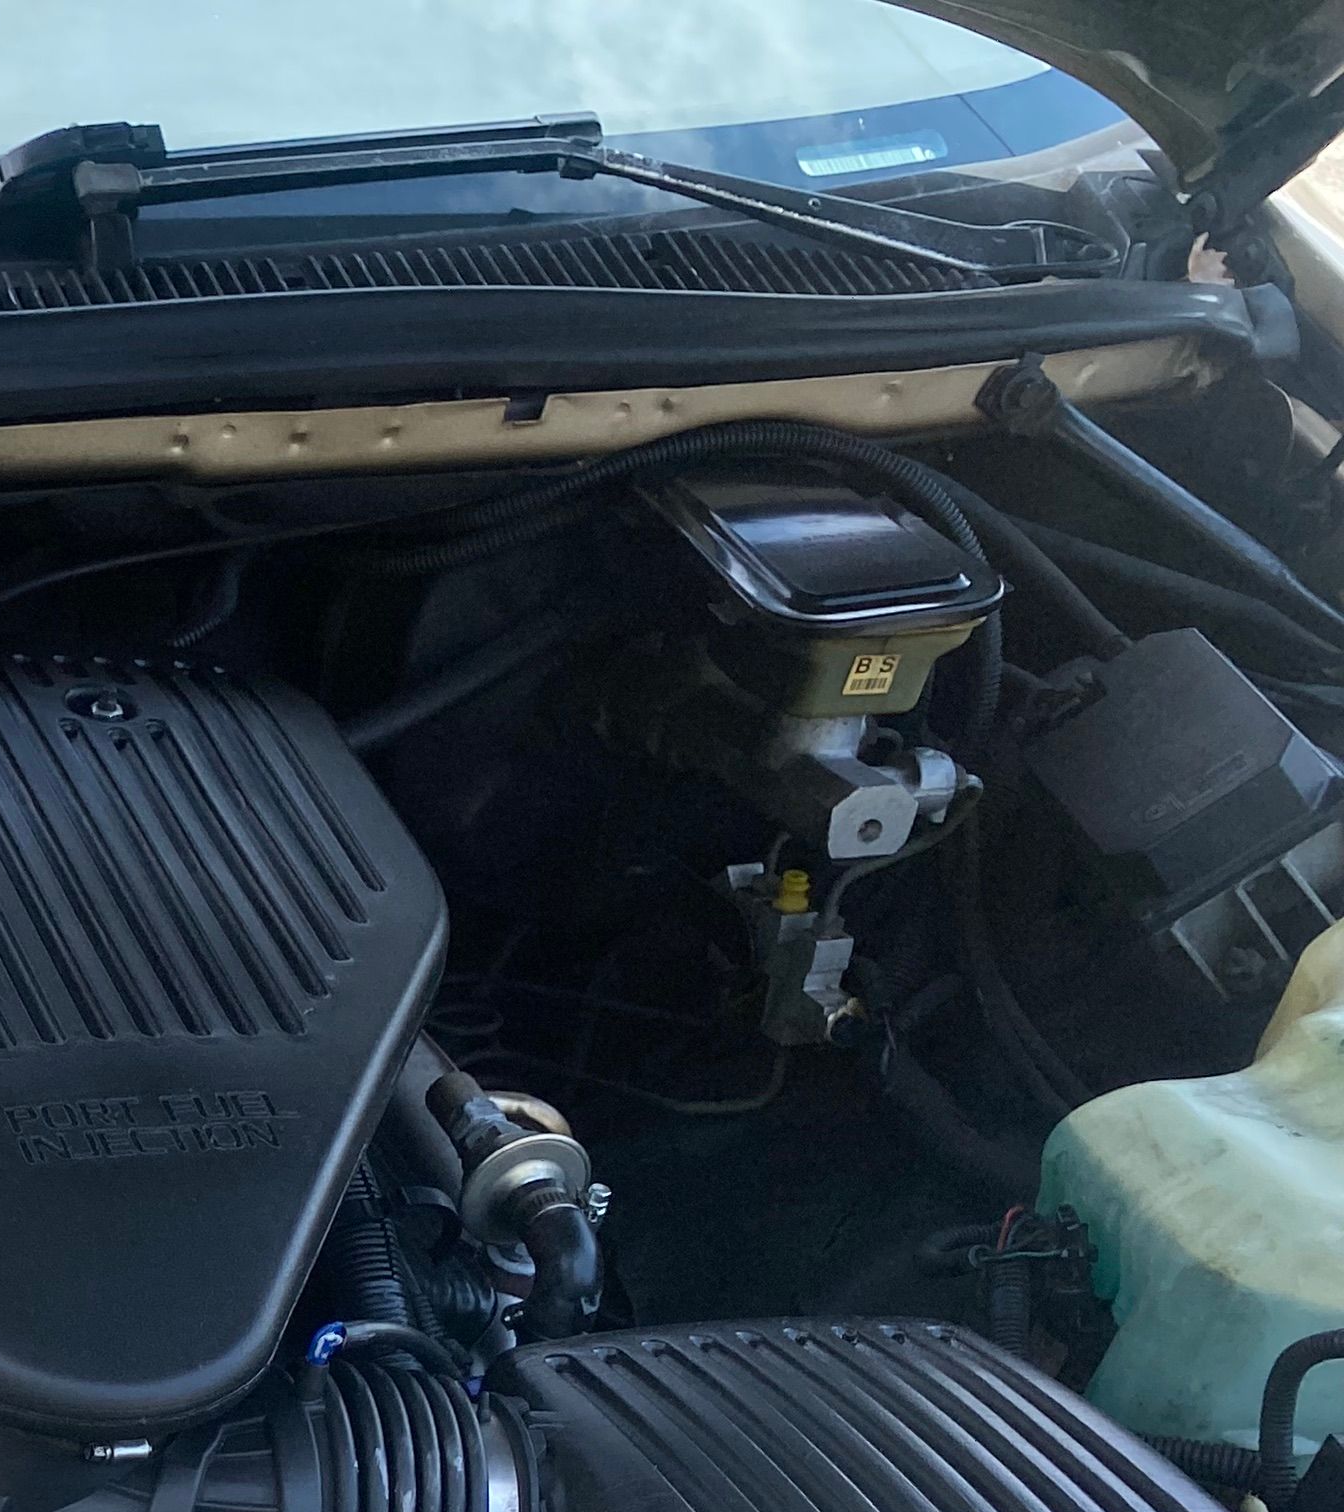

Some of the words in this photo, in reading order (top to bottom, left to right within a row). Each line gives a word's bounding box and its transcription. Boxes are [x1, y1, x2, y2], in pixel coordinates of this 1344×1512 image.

[855, 657, 872, 674] B
[880, 656, 895, 673] S
[4, 1098, 140, 1132] PORT
[161, 1089, 301, 1121] FUEL
[12, 1121, 285, 1164] INJECTION
